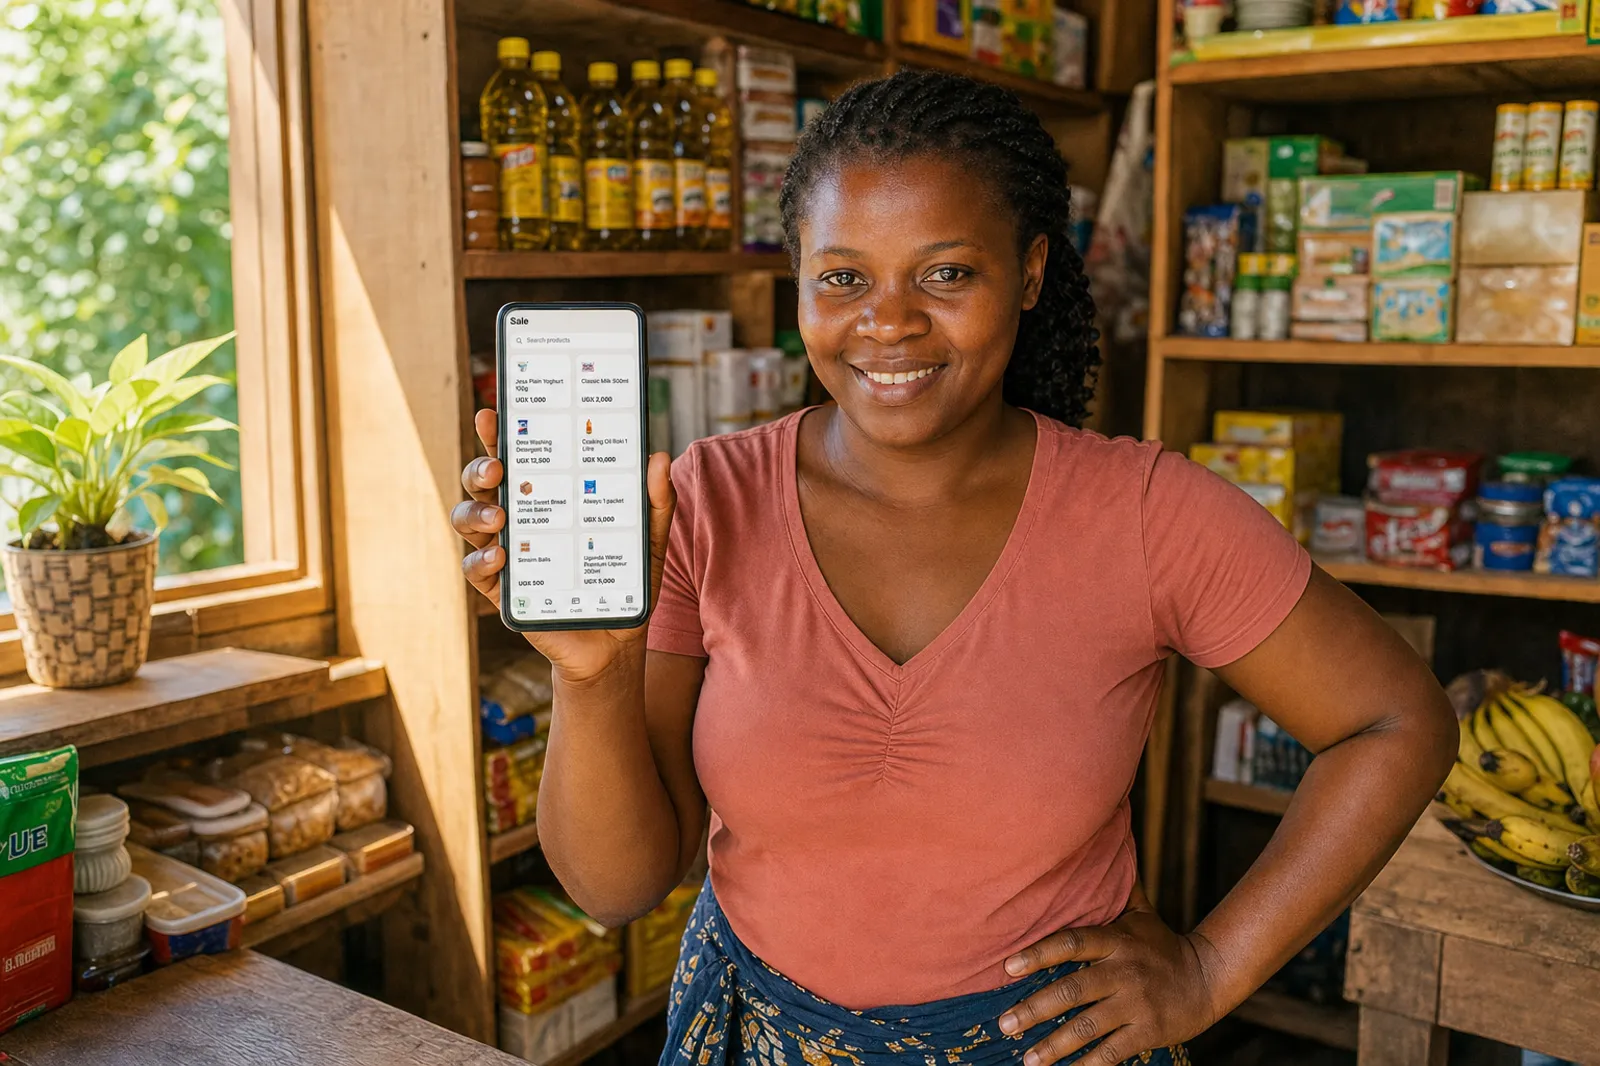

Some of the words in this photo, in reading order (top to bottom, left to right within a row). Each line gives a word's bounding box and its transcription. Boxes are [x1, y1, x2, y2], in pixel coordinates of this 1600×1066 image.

[510, 317, 529, 325] Sale
[546, 337, 571, 345] products
[543, 378, 564, 386] Yoghurt
[530, 396, 547, 404] 1,000
[595, 396, 613, 404] 2,000
